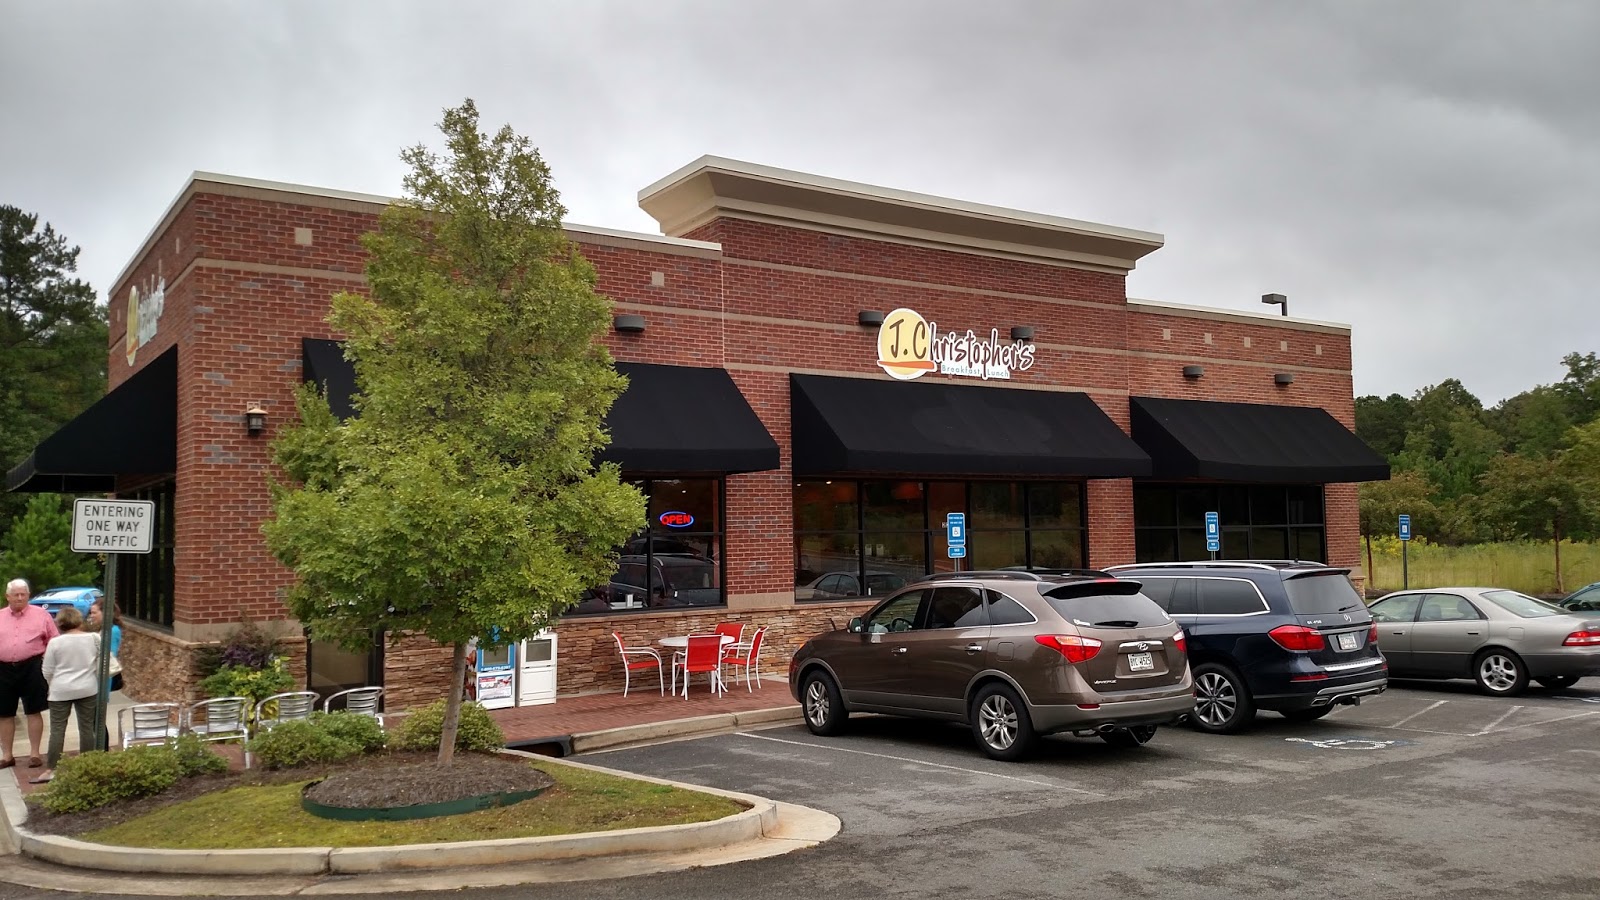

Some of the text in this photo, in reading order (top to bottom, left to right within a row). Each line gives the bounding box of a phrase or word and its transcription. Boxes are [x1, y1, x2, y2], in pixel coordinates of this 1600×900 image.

[941, 364, 1009, 378] Breakfast Lunch
[84, 505, 144, 518] ENTERING
[86, 520, 140, 533] ONE WAY
[661, 514, 691, 526] OPEN
[87, 535, 138, 547] TRAFFIC
